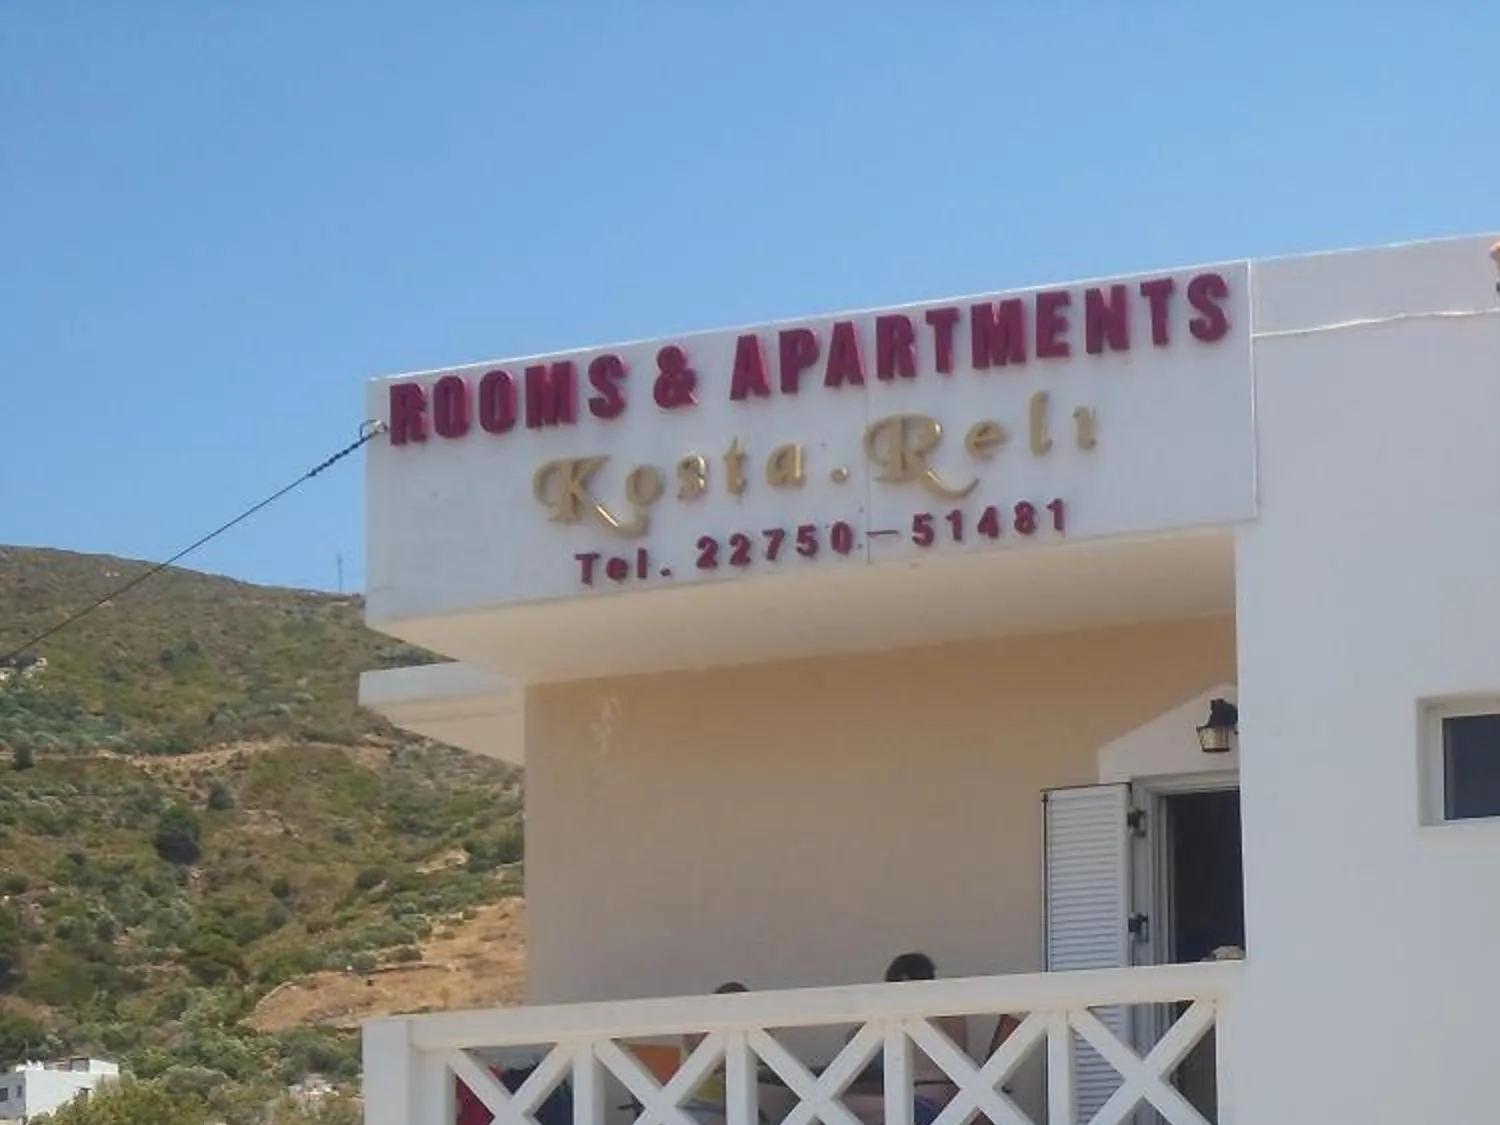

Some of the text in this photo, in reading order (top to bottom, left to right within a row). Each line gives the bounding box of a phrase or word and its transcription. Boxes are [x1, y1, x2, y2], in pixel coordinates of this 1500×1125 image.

[389, 273, 1229, 447] ROOMS & APARTMENTS
[574, 547, 672, 585] Tel.
